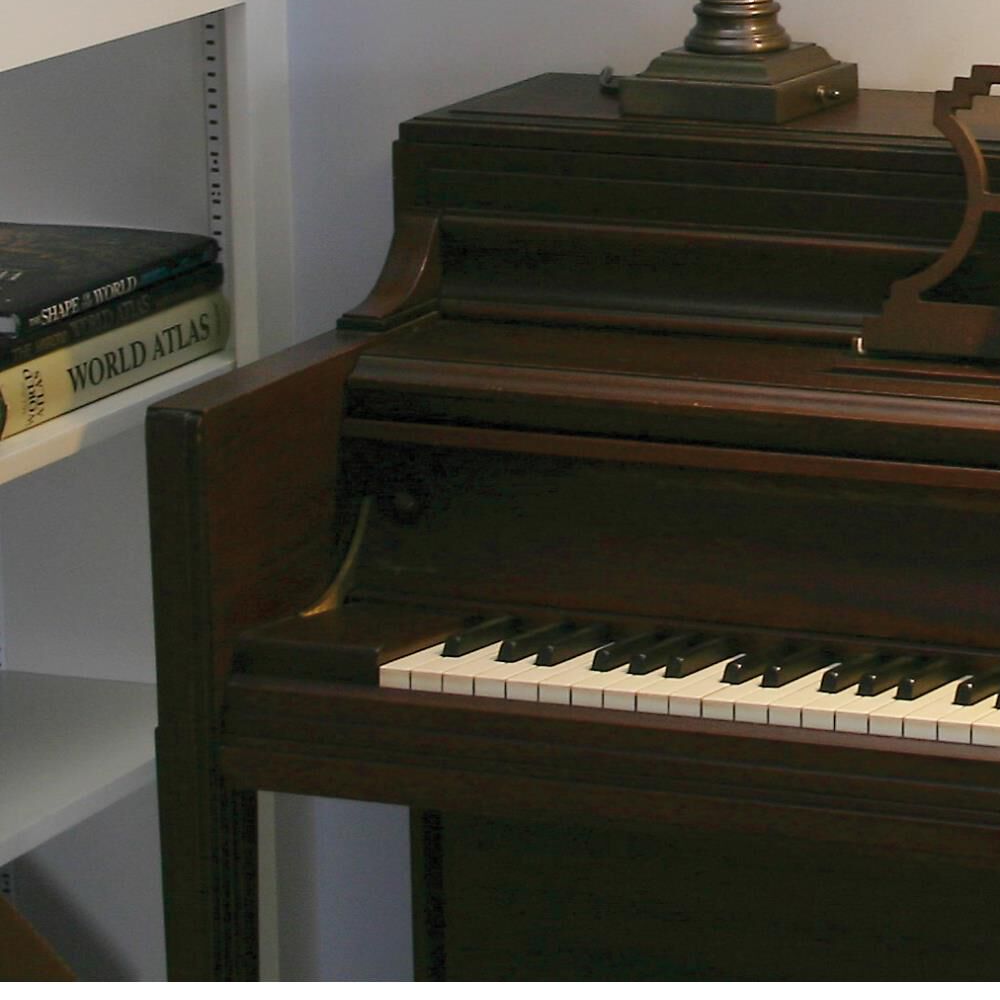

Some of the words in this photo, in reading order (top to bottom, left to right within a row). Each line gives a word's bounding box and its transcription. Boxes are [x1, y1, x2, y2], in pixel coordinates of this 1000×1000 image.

[41, 297, 80, 325] SHAPE
[92, 276, 137, 303] WORLD
[66, 340, 147, 393] WORLD
[152, 313, 211, 361] ATLAS
